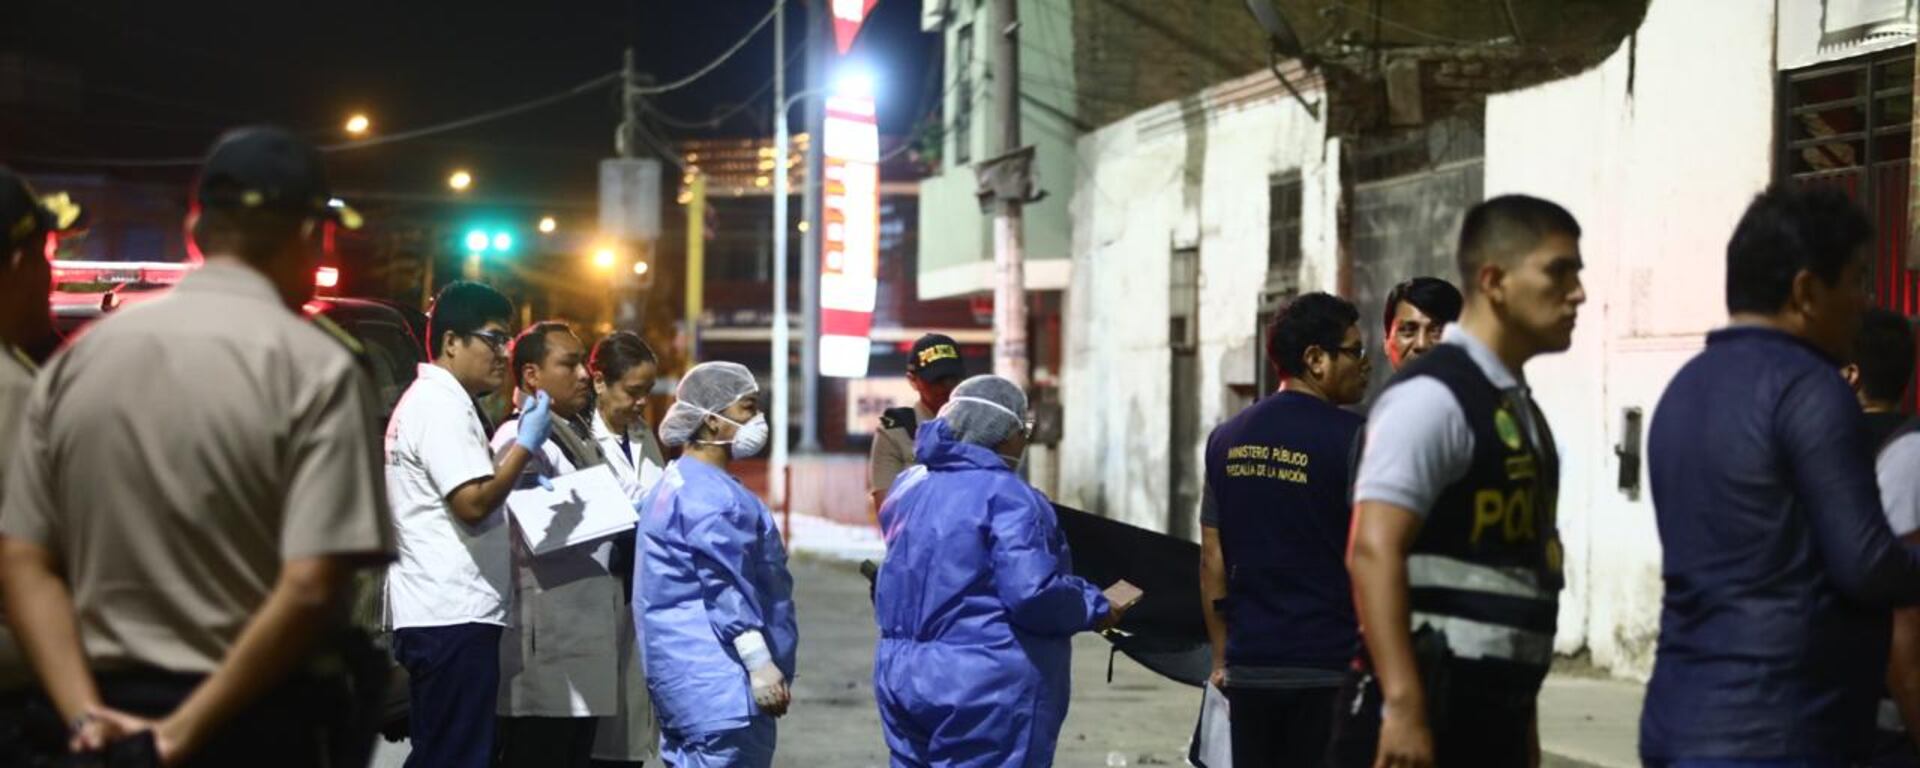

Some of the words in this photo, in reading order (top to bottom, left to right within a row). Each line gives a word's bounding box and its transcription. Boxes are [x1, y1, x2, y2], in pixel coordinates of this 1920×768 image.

[1227, 445, 1269, 460] MINISTERIO
[1271, 445, 1308, 467] PÚBLICO
[1256, 464, 1267, 476] DE
[1267, 466, 1276, 478] LA
[1277, 466, 1308, 484] NACIÓN
